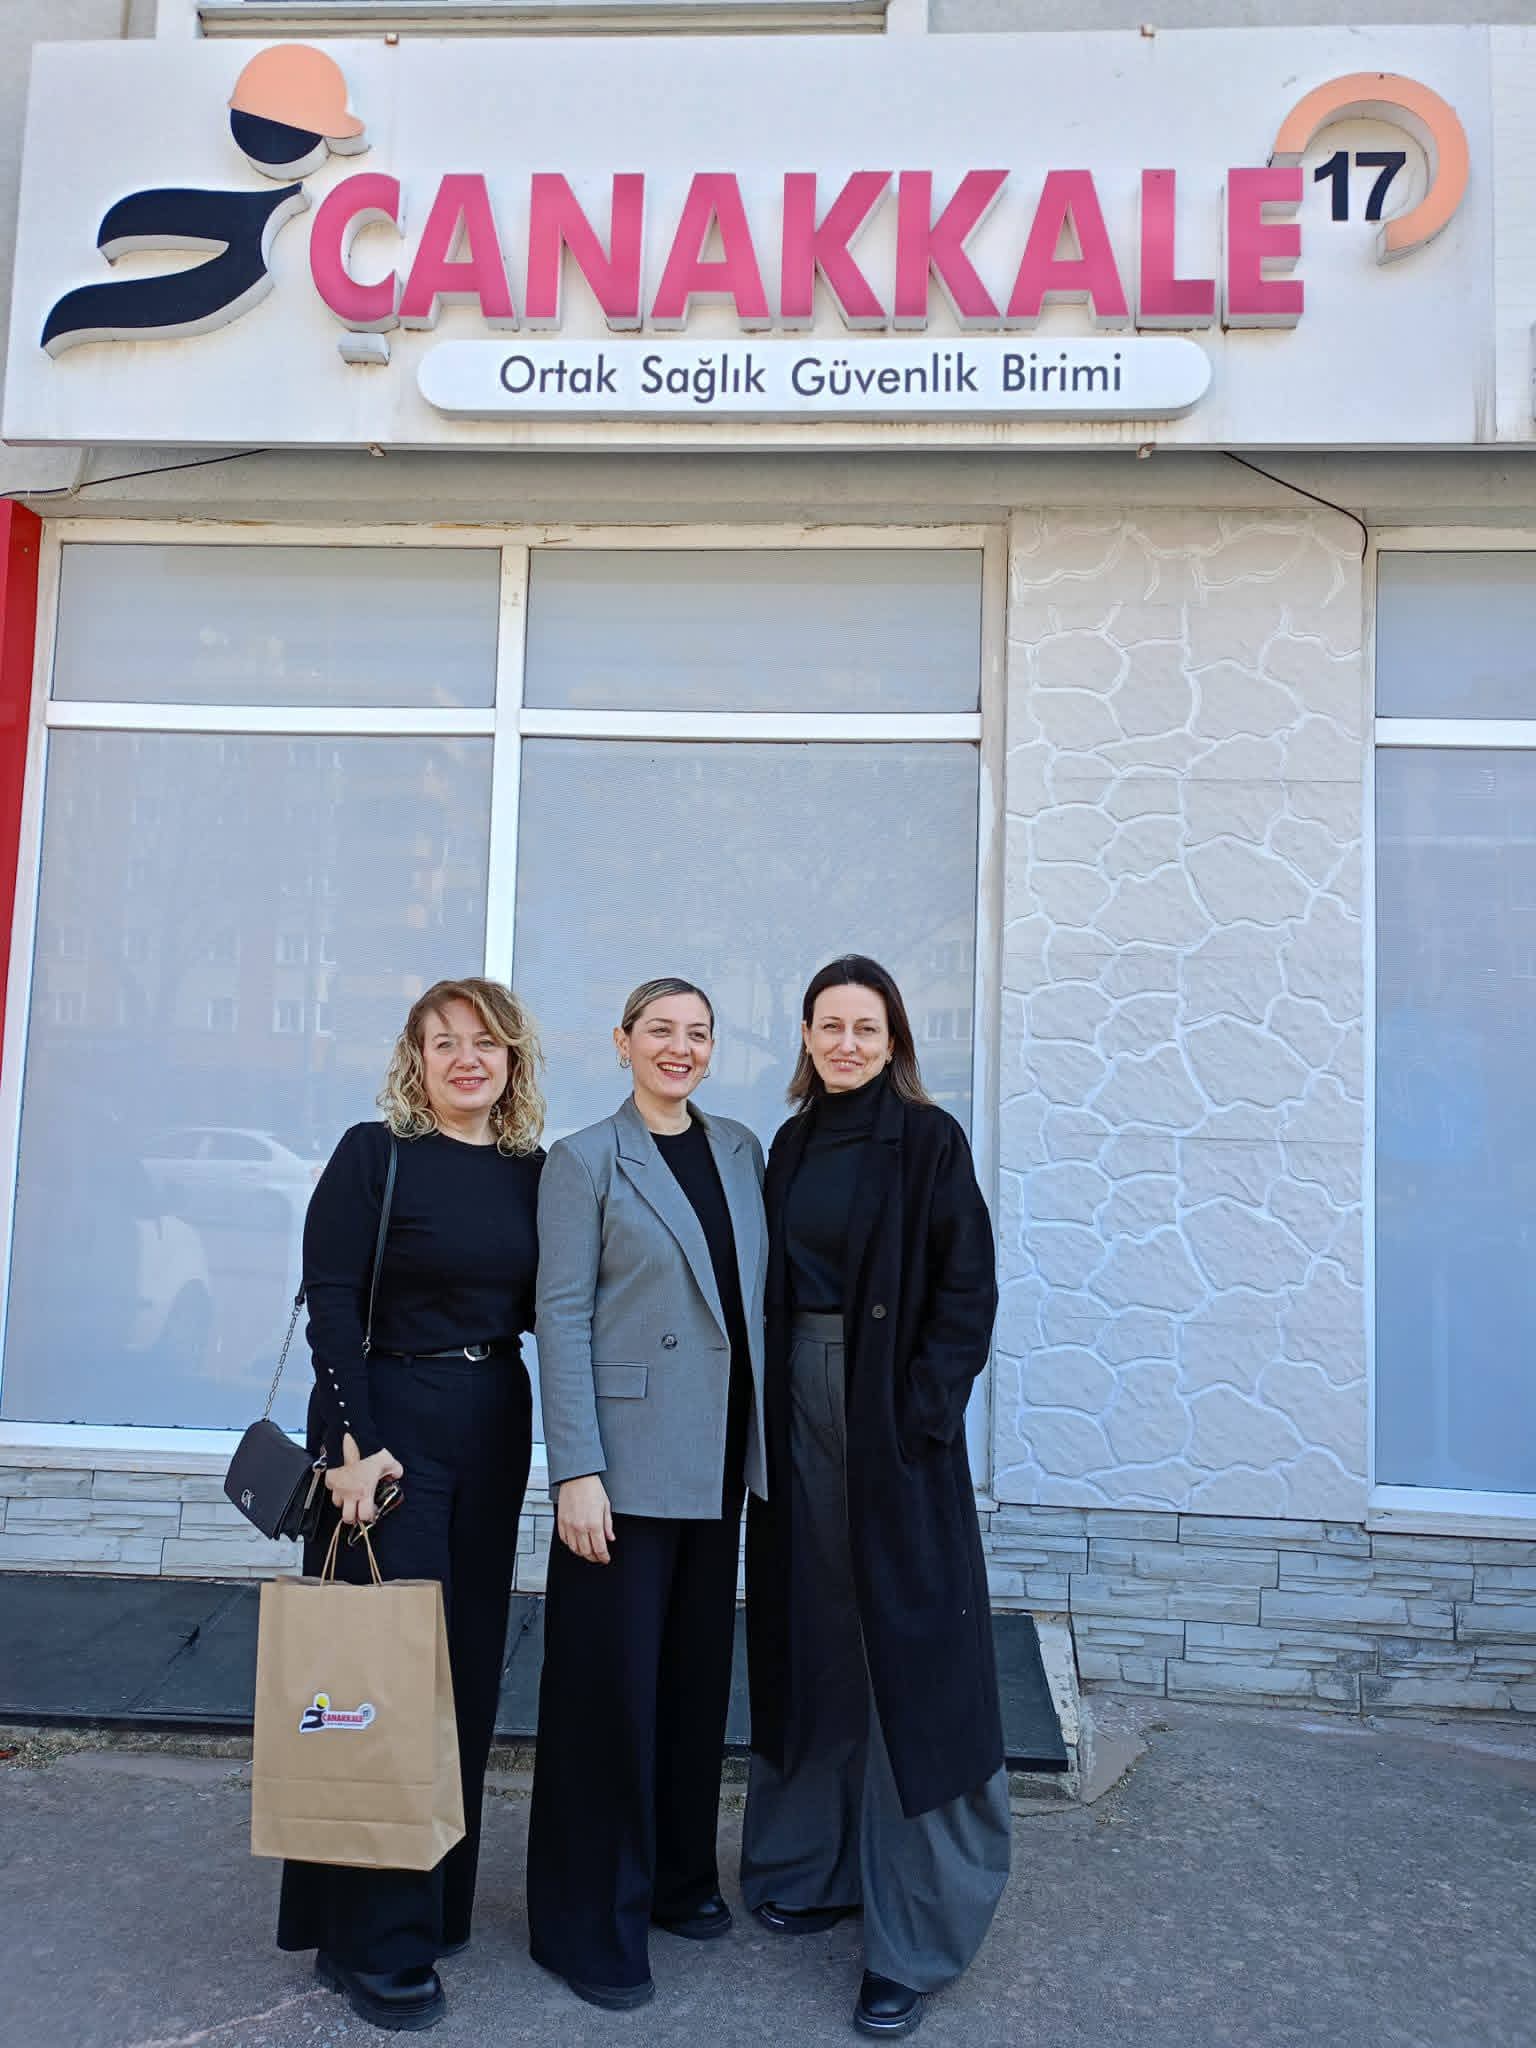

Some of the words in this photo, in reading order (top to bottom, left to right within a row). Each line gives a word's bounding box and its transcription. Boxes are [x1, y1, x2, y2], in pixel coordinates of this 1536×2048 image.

[1313, 151, 1407, 222] 17
[500, 354, 617, 394] Ortak
[641, 353, 766, 403] Sağlık
[791, 352, 979, 396] Güvenlik
[1002, 353, 1121, 392] Birimi
